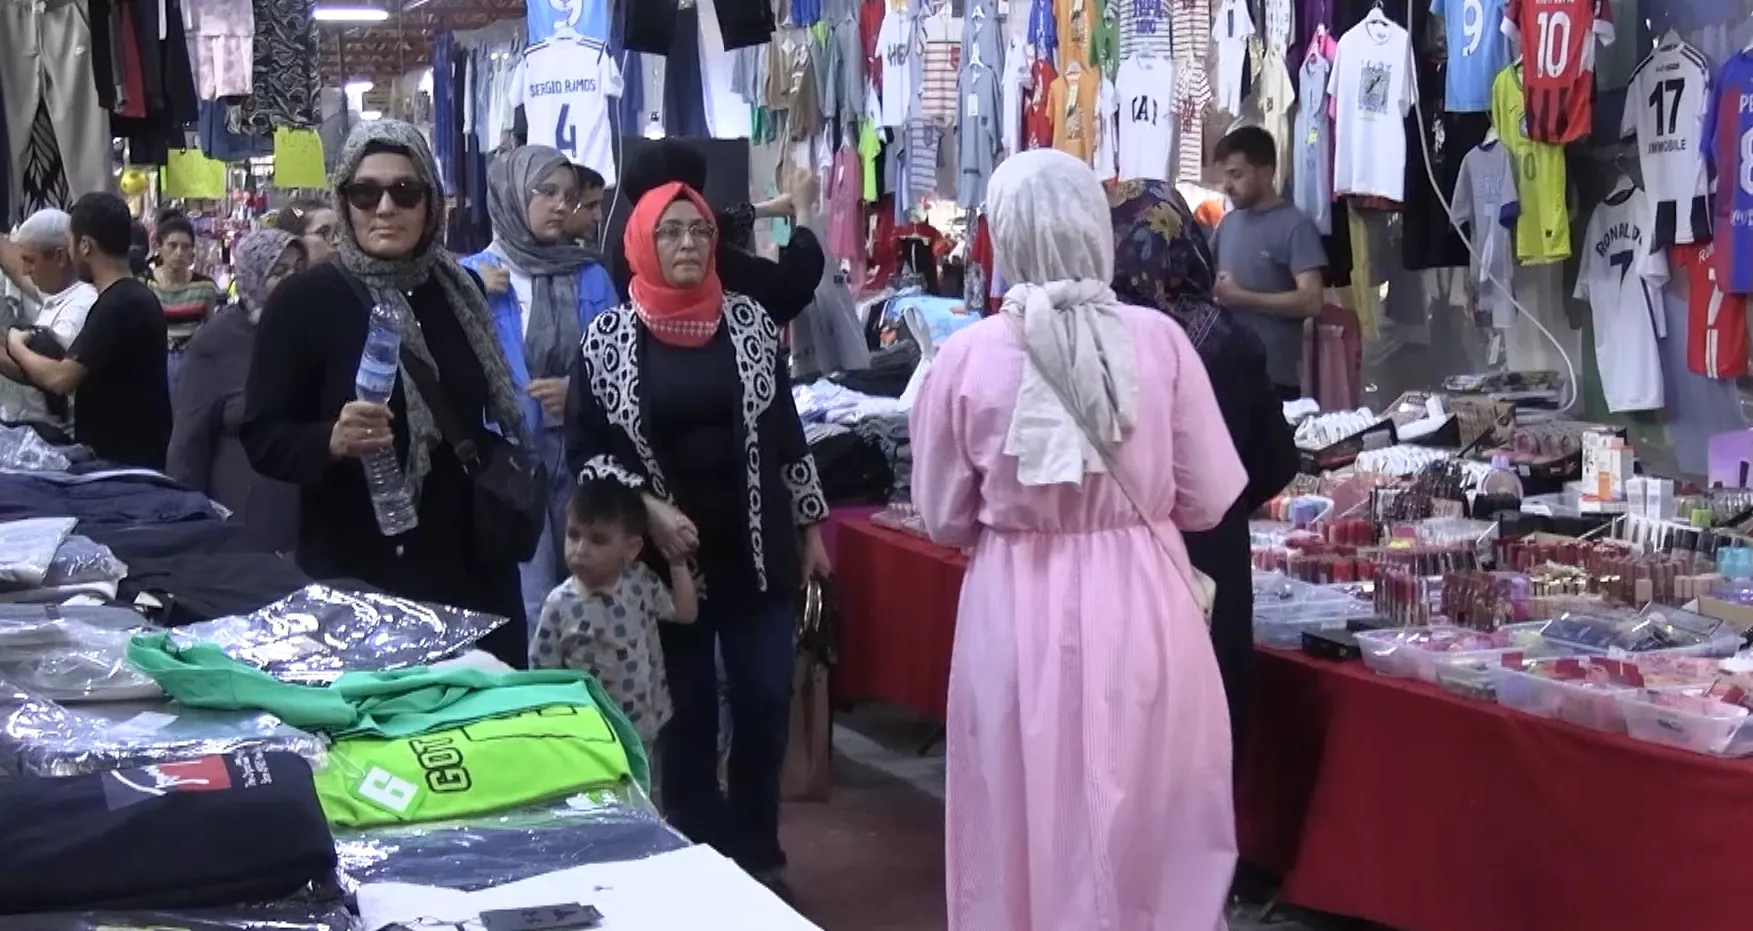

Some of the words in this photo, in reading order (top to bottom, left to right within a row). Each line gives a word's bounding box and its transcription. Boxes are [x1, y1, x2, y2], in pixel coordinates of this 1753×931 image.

[1463, 0, 1483, 57] 9
[1537, 11, 1571, 78] 10
[529, 80, 562, 97] SERGIO
[564, 78, 596, 94] RAMOS
[1648, 77, 1685, 136] 17
[555, 103, 577, 158] 4
[1648, 139, 1686, 153] IMMOBILE
[1610, 249, 1634, 289] 7
